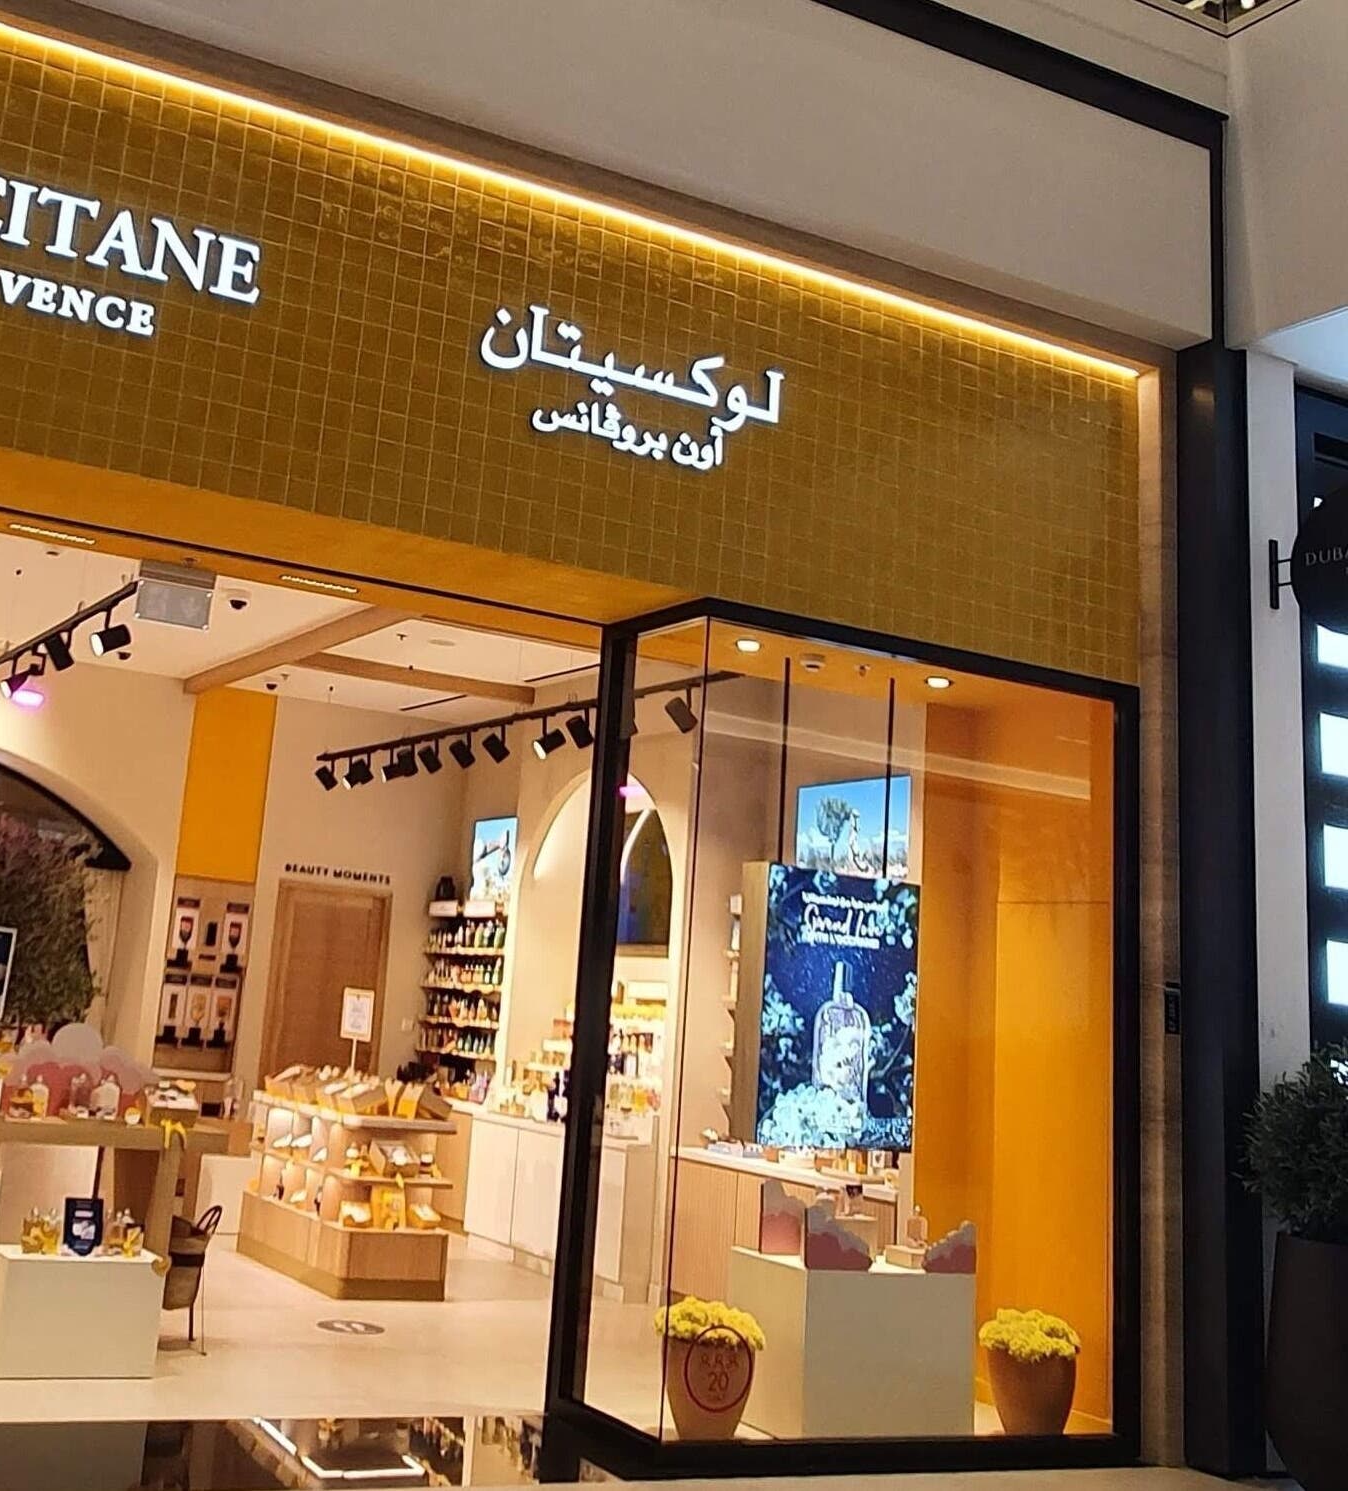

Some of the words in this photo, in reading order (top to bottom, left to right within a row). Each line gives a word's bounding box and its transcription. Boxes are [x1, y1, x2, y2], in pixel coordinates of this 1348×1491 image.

[480, 304, 785, 432] لوكسيتان
[285, 863, 329, 878] BEAUTY
[333, 868, 391, 885] MOMENTS
[708, 1372, 729, 1391] 20
